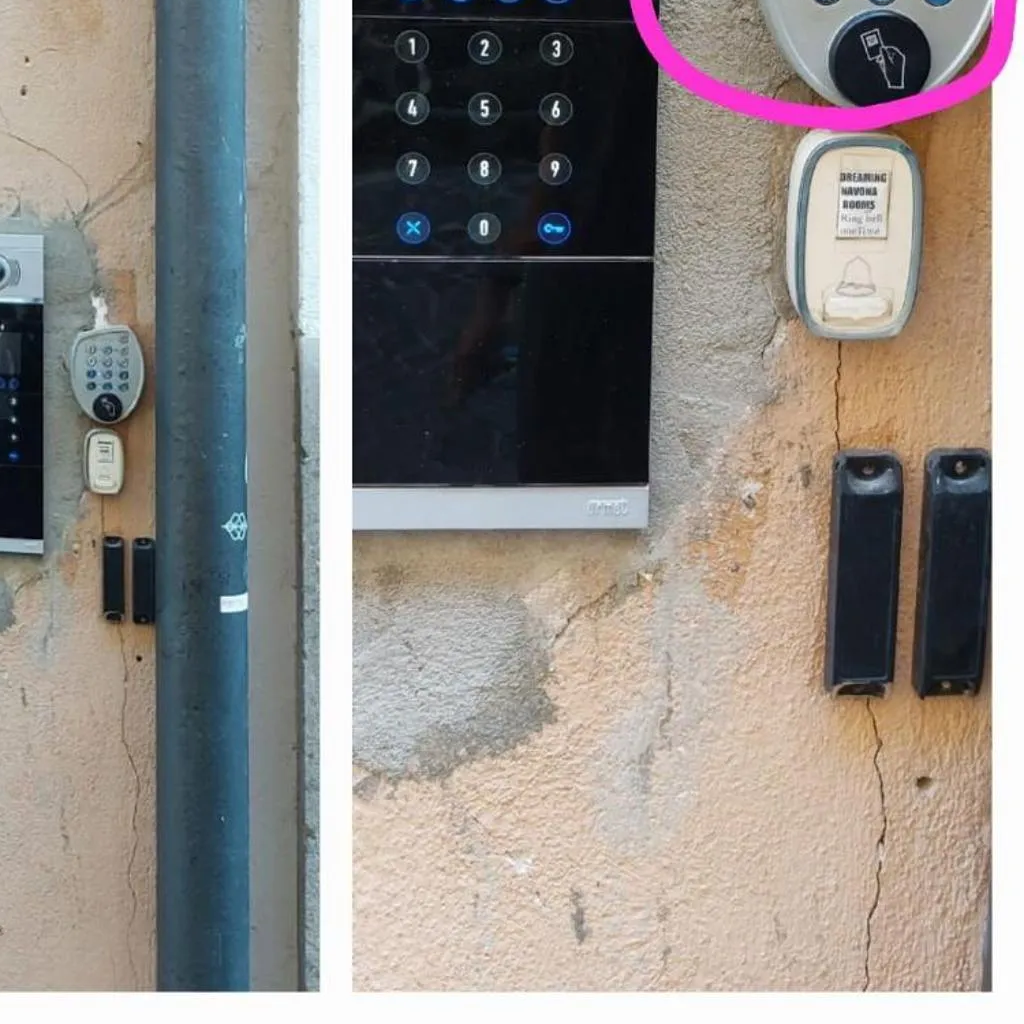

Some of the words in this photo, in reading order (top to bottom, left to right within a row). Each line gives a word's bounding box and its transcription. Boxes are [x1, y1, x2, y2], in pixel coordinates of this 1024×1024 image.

[409, 38, 415, 55] 1
[481, 39, 489, 56] 2
[553, 40, 560, 57] 3
[408, 99, 417, 116] 4
[481, 100, 489, 117] 5
[552, 101, 560, 118] 6
[408, 159, 417, 176] 7
[480, 160, 489, 177] 8
[551, 161, 559, 177] 9
[839, 172, 887, 183] DREAMING
[841, 186, 878, 196] NAVONA
[842, 200, 875, 210] ROOMS
[480, 219, 489, 236] 0
